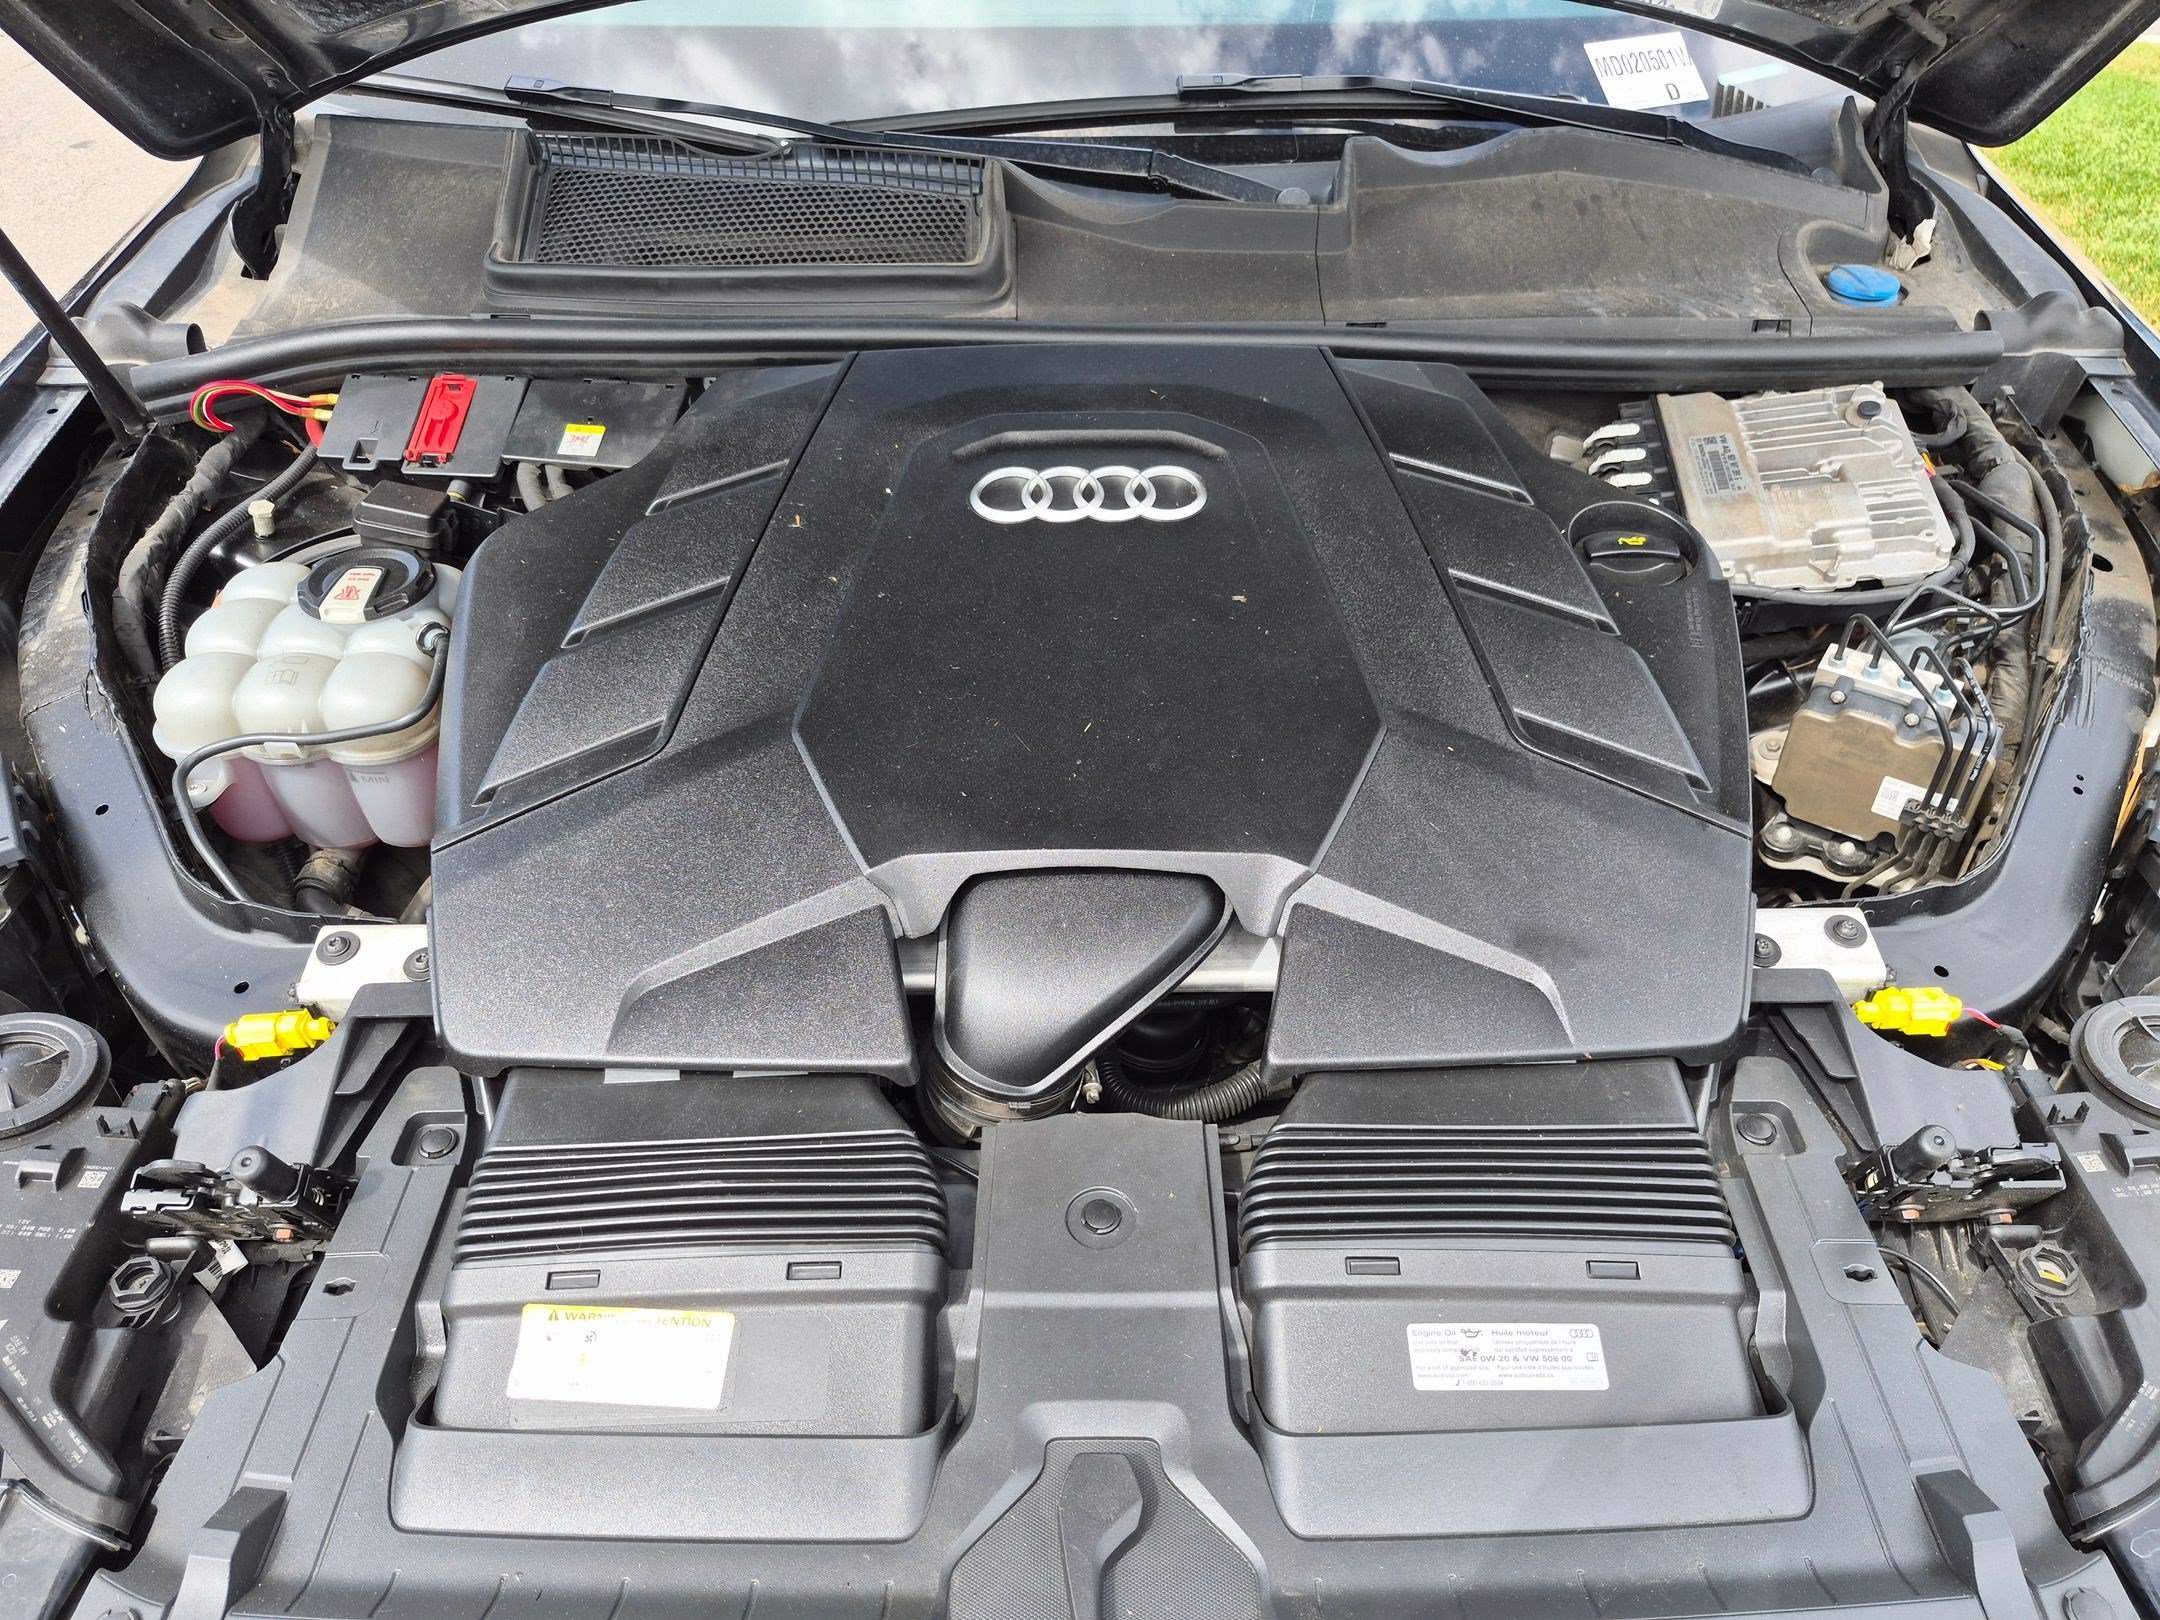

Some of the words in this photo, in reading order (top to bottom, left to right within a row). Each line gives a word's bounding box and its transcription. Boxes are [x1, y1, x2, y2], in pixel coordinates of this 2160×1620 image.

[1665, 83, 1681, 100] D
[361, 775, 390, 784] MIN
[1412, 1329, 1441, 1337] Engine
